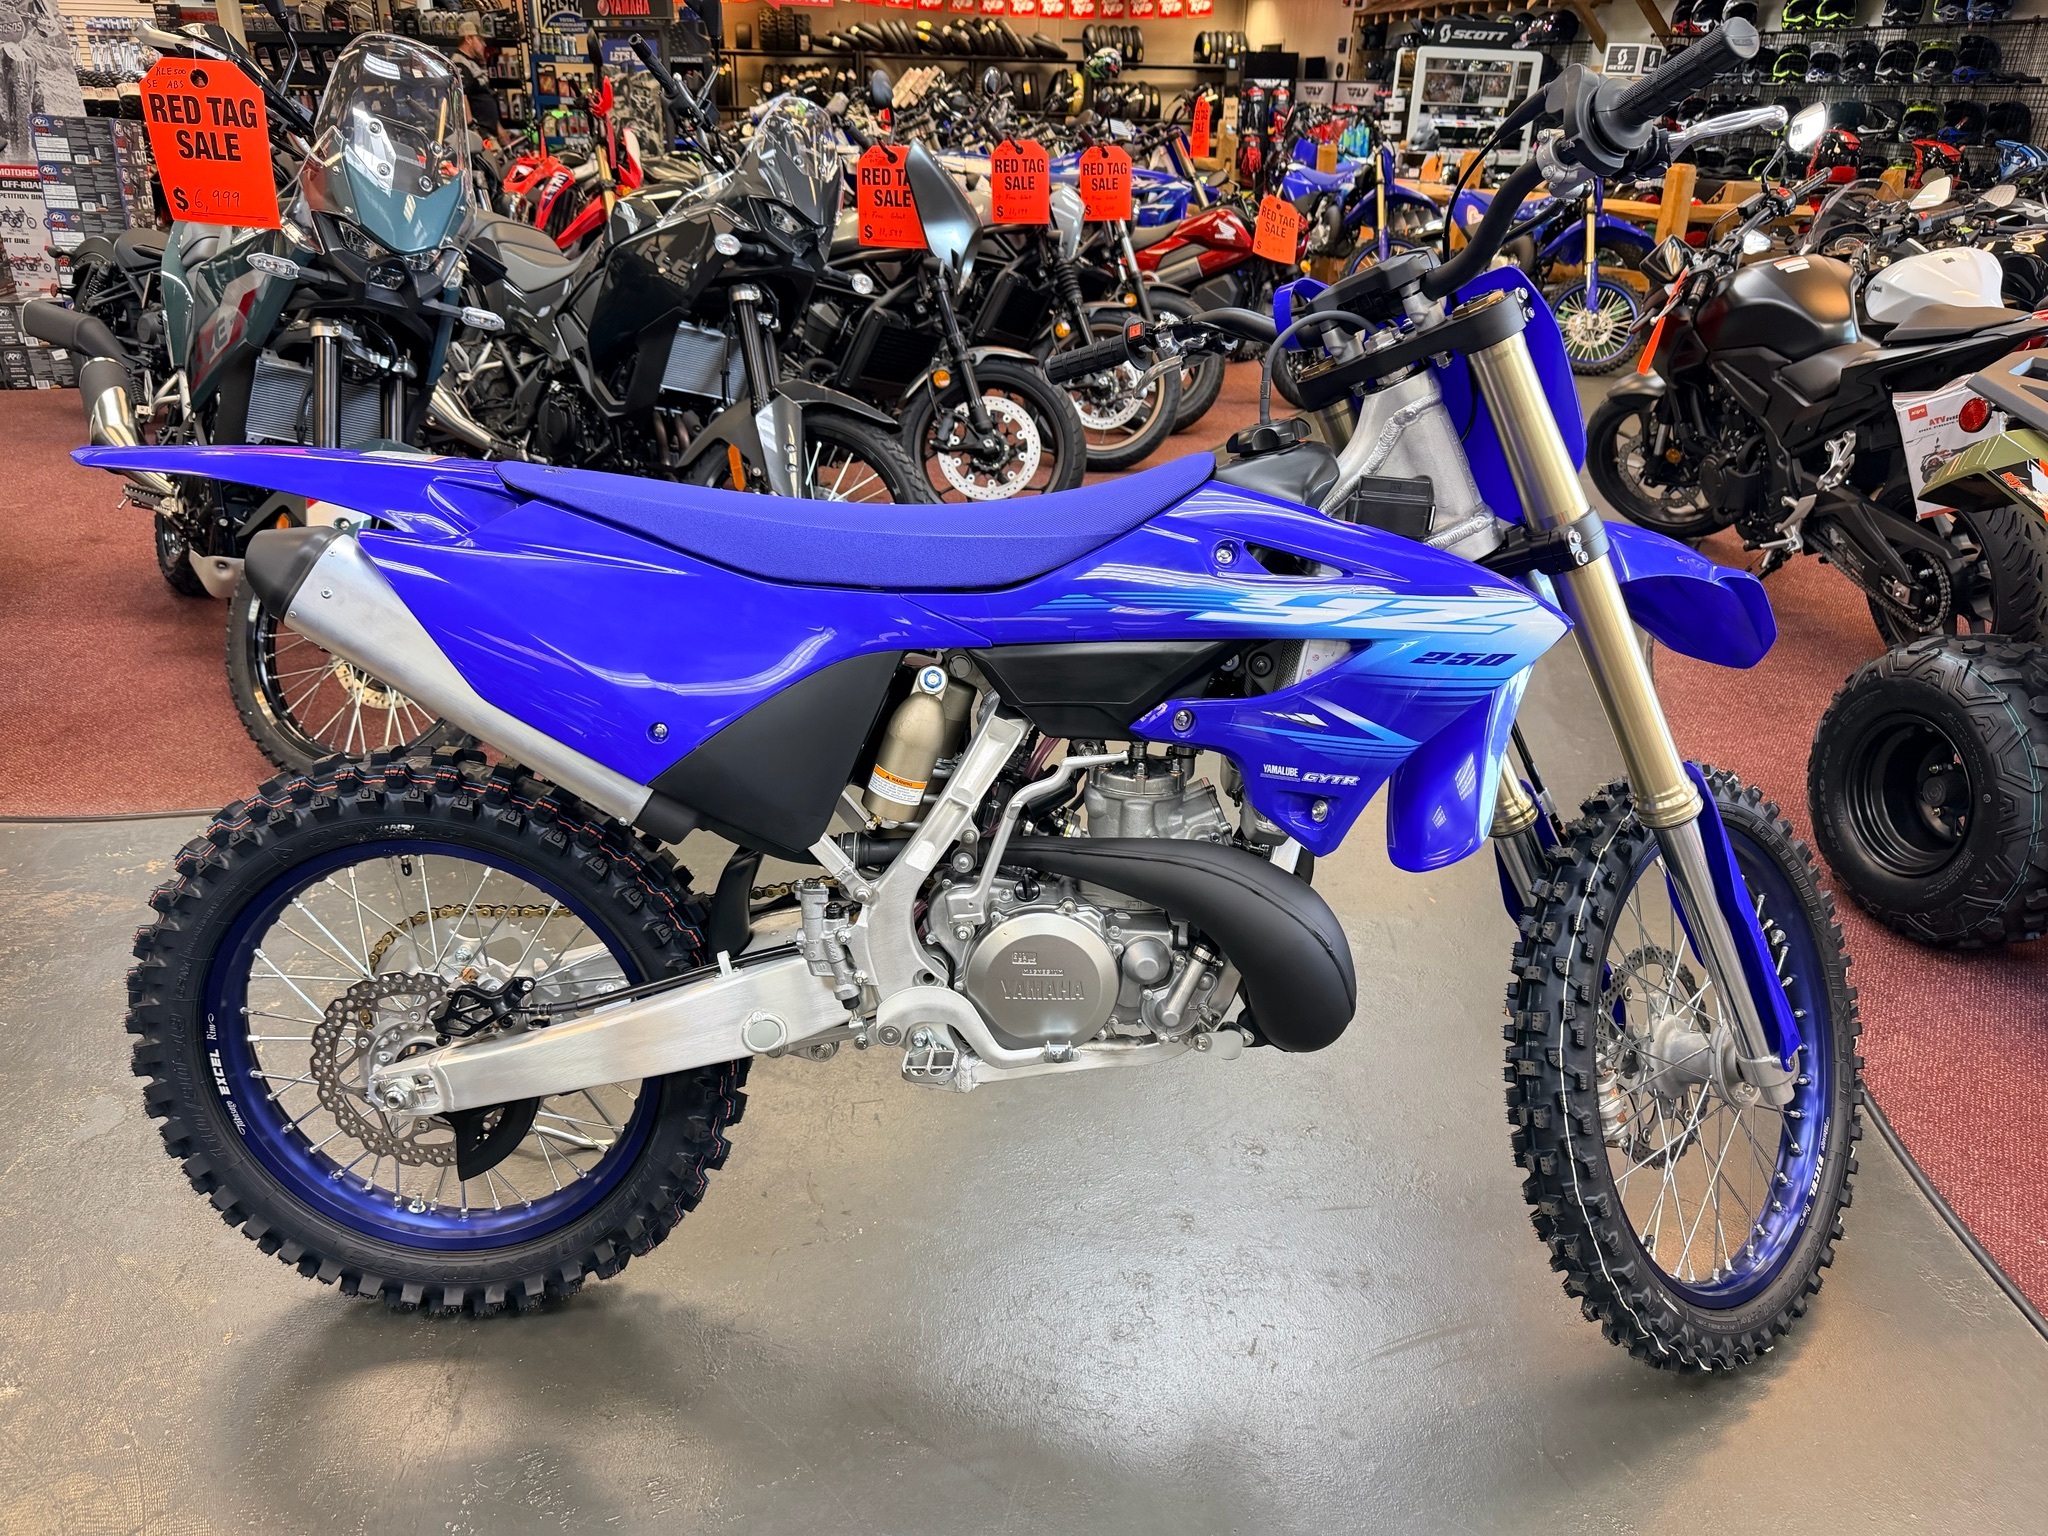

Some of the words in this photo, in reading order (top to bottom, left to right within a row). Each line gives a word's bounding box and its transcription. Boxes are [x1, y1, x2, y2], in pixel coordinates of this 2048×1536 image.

[609, 0, 651, 14] YAMAHA
[1451, 29, 1508, 41] SCOTT
[609, 51, 630, 61] LET'S
[167, 80, 184, 88] ABS
[148, 94, 201, 124] RED
[206, 97, 258, 128] TAG
[176, 130, 241, 161] SALE
[995, 159, 1019, 173] RED
[1022, 159, 1045, 173] TAG
[1083, 163, 1104, 176] RED
[1107, 162, 1127, 175] TAG
[861, 168, 891, 185] RED
[1004, 176, 1035, 190] SALE
[2, 180, 42, 189] OFF-ROA
[1091, 178, 1118, 191] SALE
[173, 187, 189, 212] $
[194, 188, 241, 212] 6,999
[874, 189, 912, 207] SALE
[1262, 206, 1277, 222] RED
[1279, 214, 1295, 228] TAG
[864, 224, 873, 239] $
[1265, 222, 1287, 238] SALE
[1929, 416, 1946, 426] ATV
[1409, 652, 1518, 666] 250
[892, 778, 912, 786] WARNING
[1263, 764, 1298, 777] YAMALUBE
[1302, 772, 1360, 786] GYTR
[1000, 980, 1085, 1000] YAMAHA
[206, 1013, 217, 1040] Rim
[209, 1049, 231, 1096] EXCEL
[1808, 1154, 1824, 1197] EXCEL
